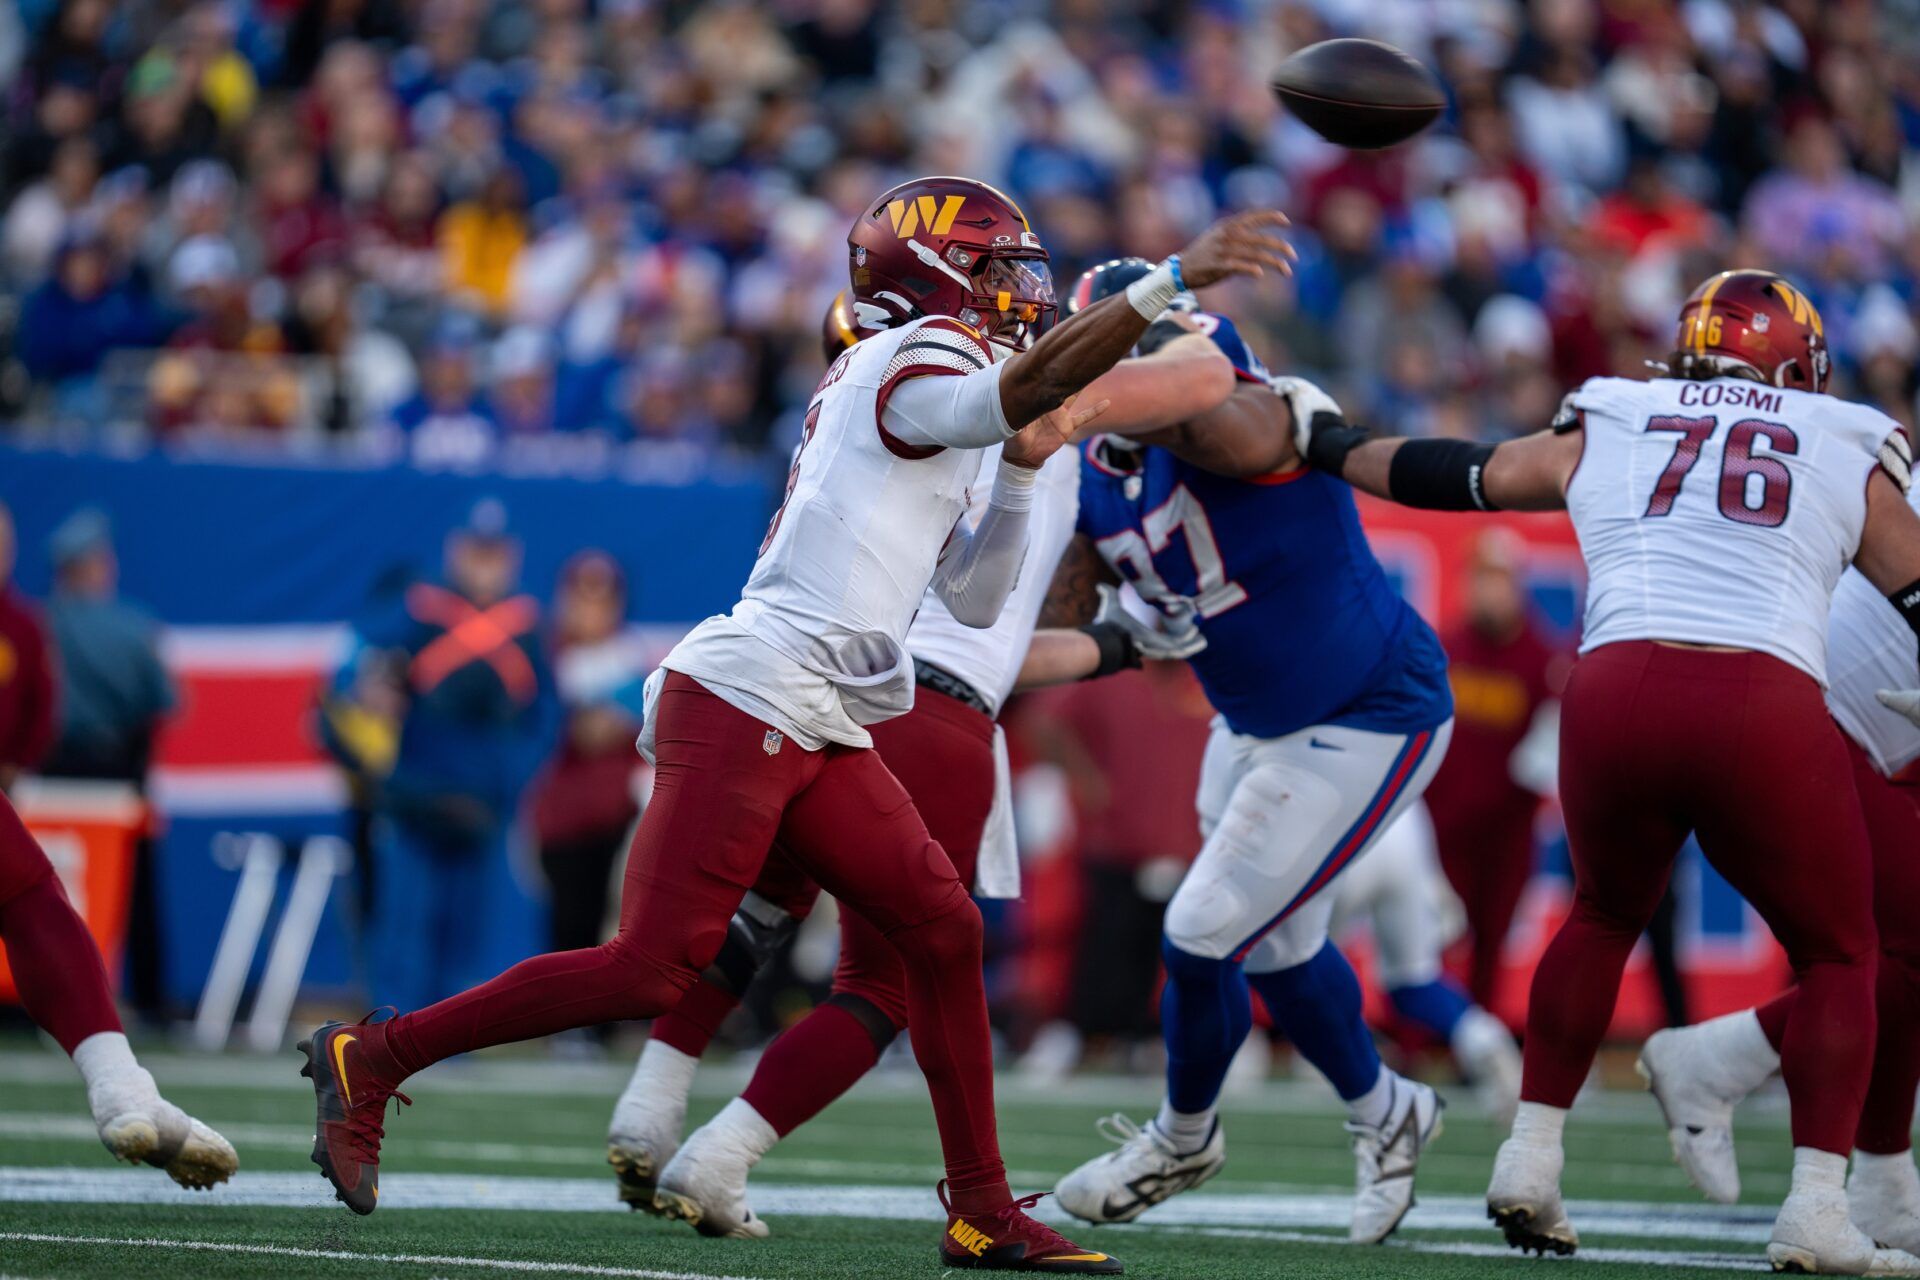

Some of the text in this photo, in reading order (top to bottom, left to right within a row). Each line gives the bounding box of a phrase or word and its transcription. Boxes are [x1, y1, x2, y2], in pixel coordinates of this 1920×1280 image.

[1680, 383, 1782, 413] COSMI
[1642, 414, 1799, 528] 76
[948, 1217, 994, 1257] NIKE
